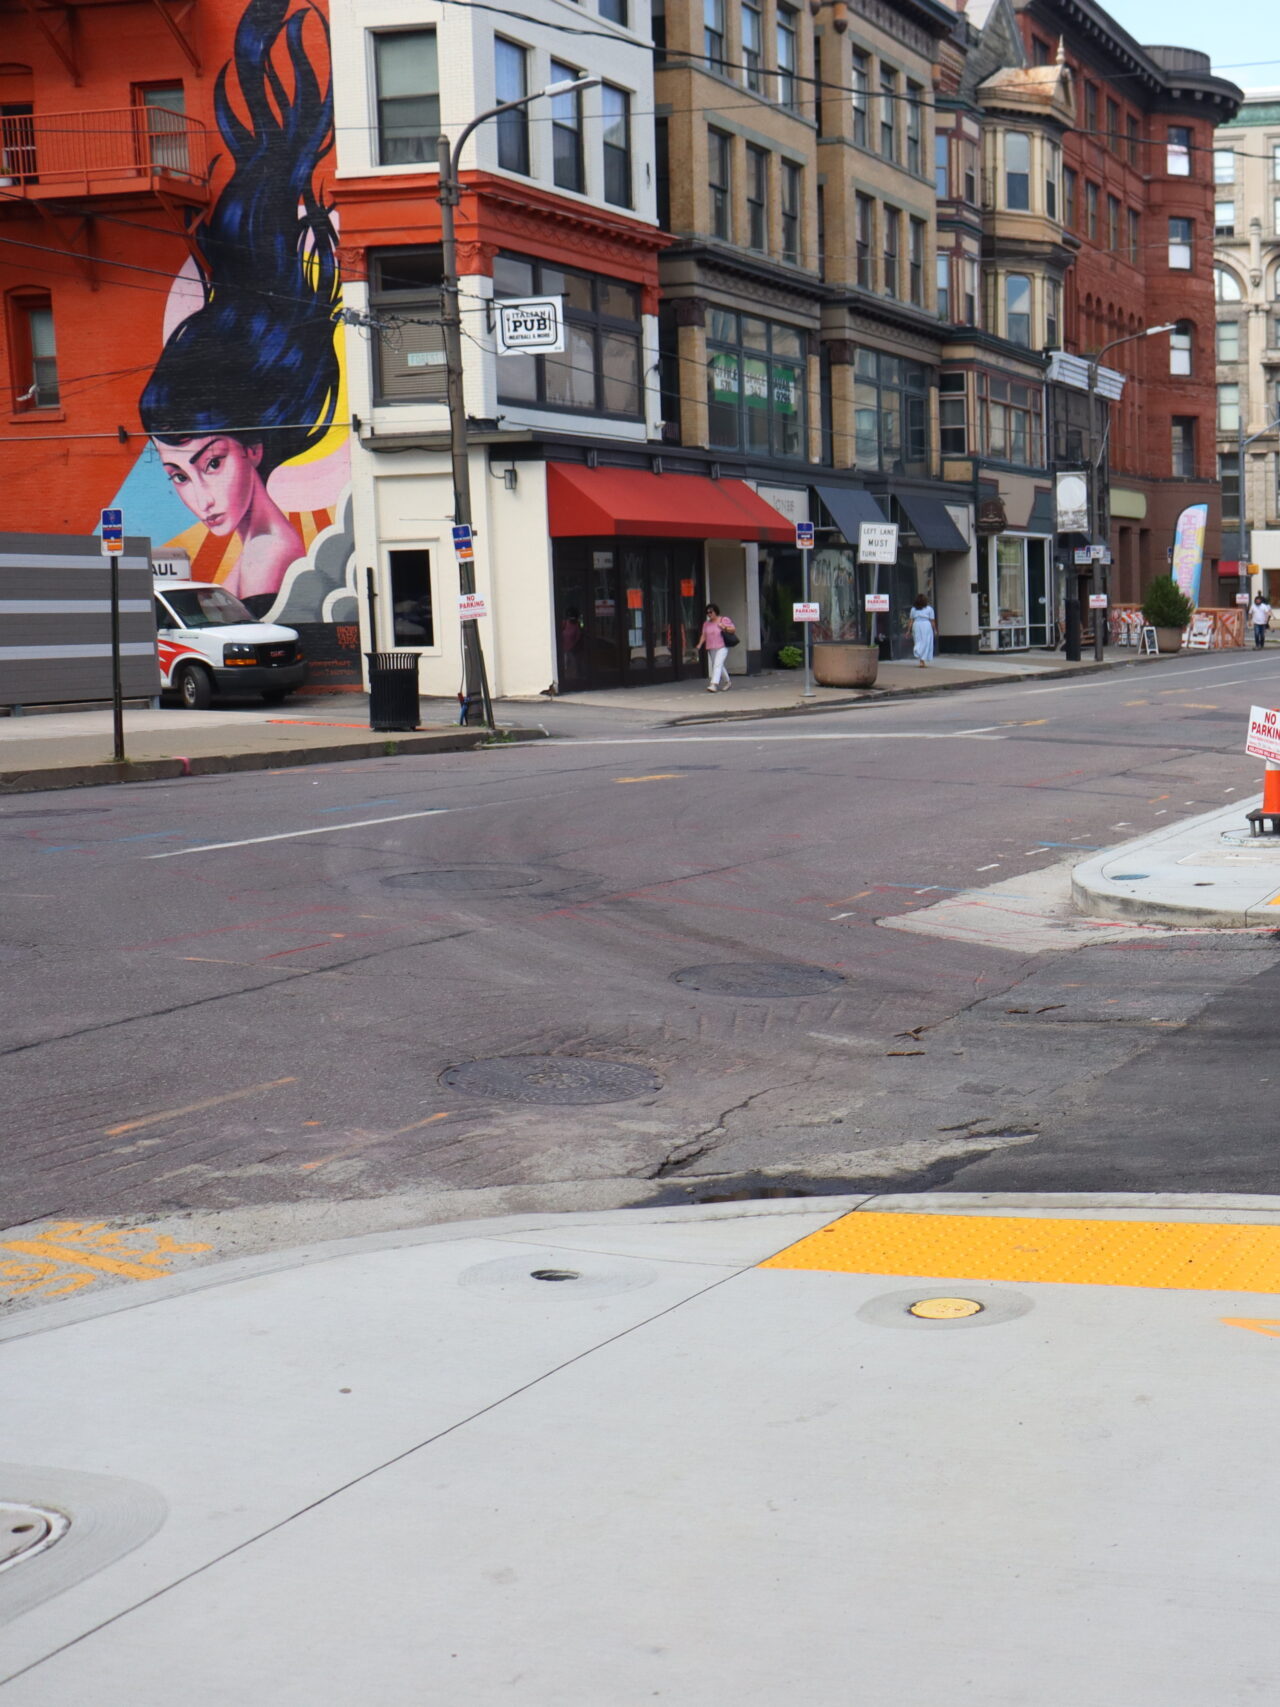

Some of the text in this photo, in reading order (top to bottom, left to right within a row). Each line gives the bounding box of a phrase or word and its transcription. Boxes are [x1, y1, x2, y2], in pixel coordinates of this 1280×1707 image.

[512, 310, 546, 319] ITALIAN
[512, 318, 547, 332] PUB
[880, 528, 895, 536] LANE
[868, 539, 888, 547] MUST
[459, 600, 485, 609] PARKING
[1264, 711, 1277, 725] NO
